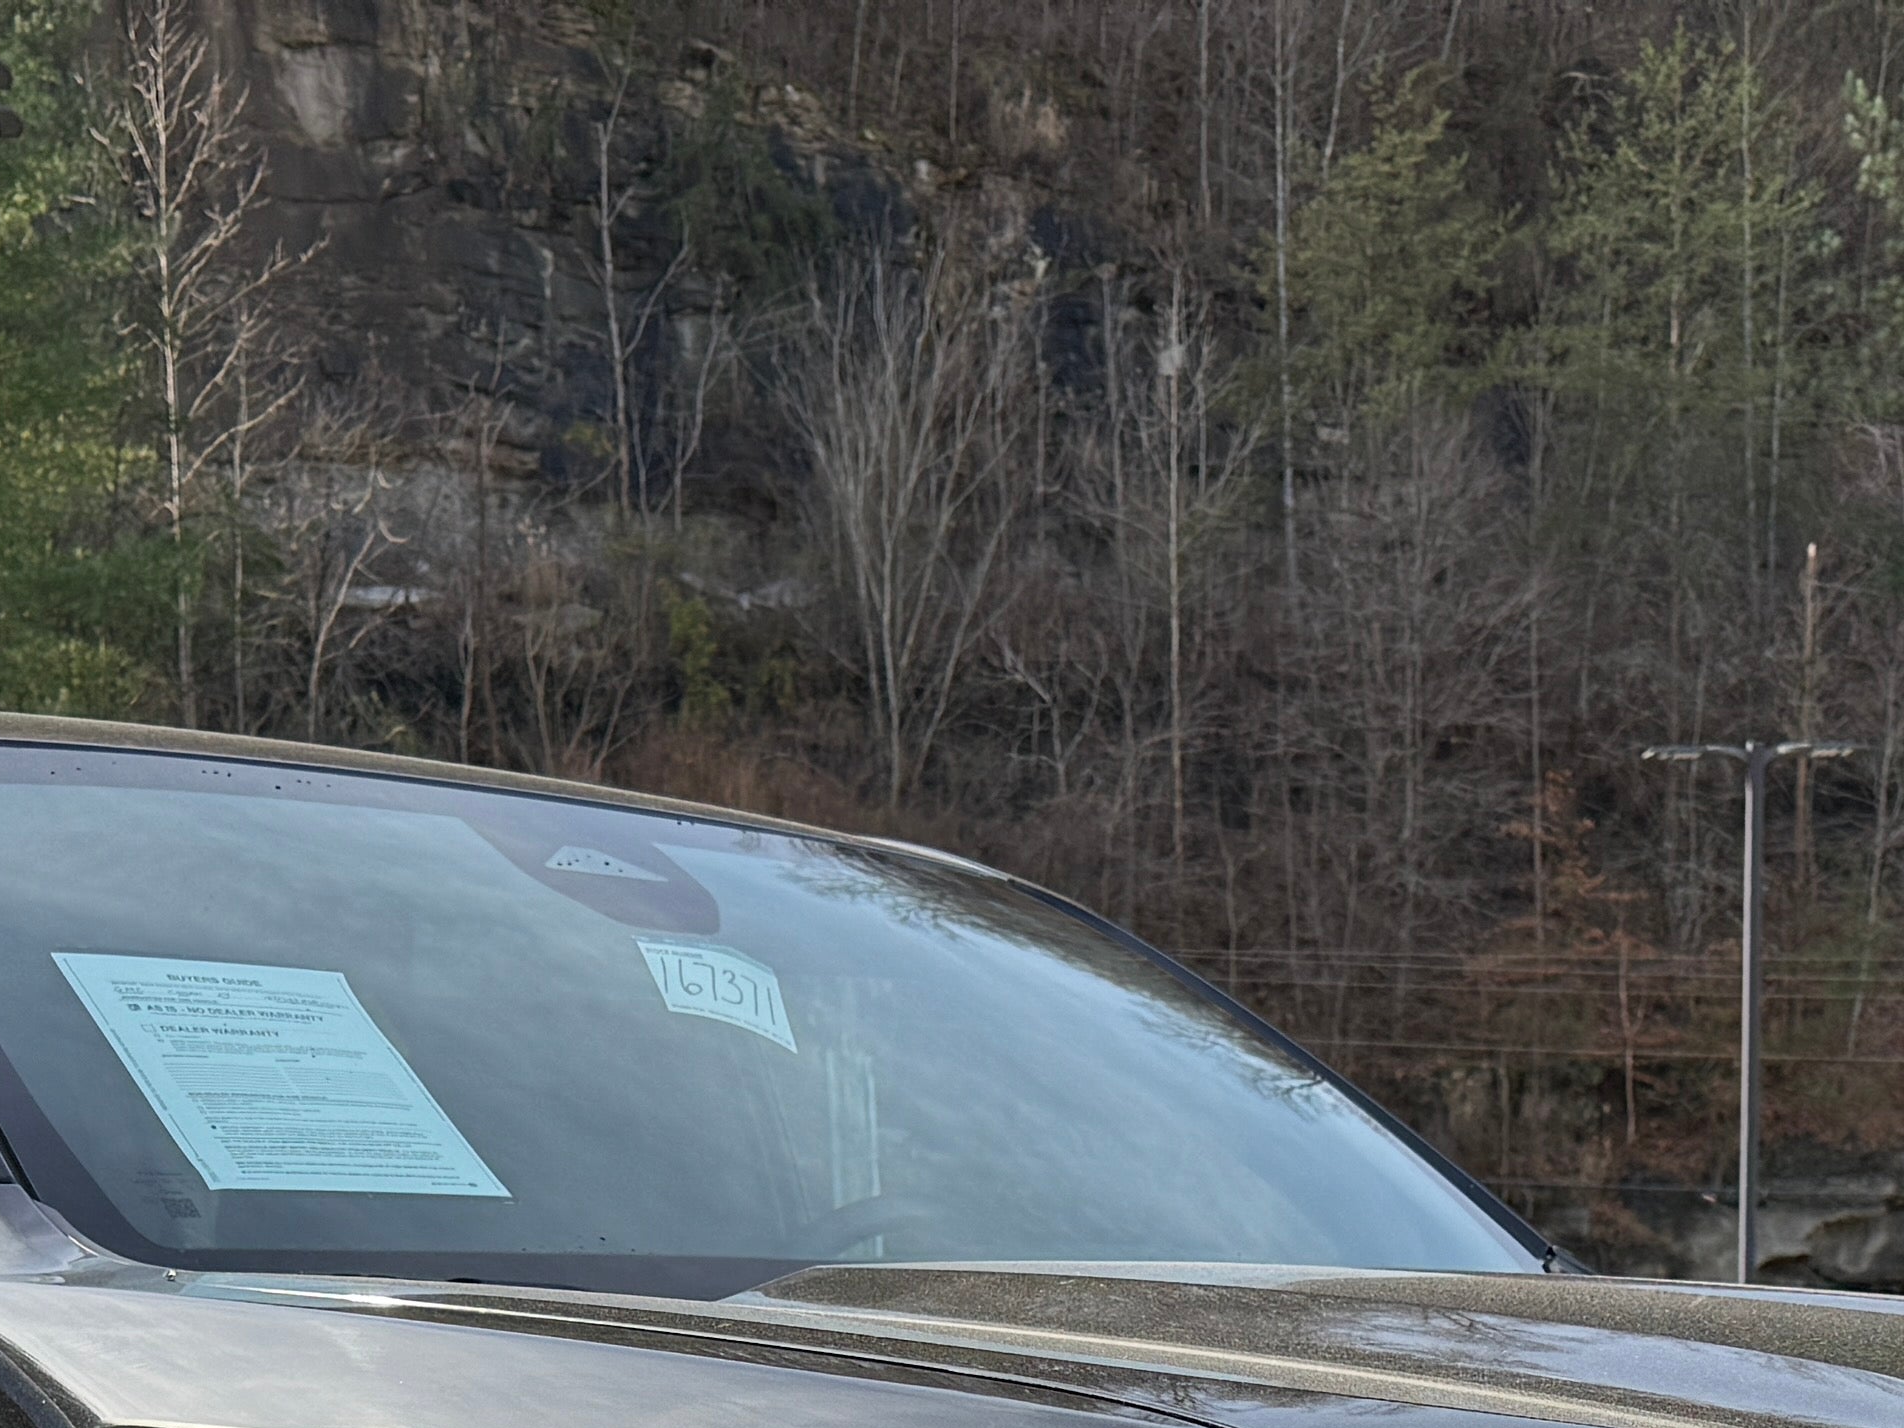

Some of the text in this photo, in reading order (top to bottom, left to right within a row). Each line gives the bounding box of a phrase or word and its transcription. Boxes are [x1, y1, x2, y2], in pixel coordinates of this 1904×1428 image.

[166, 973, 263, 988] BUYERS GUIDE
[660, 956, 777, 1026] 167371
[147, 1004, 164, 1012] AS
[187, 1006, 205, 1014] NO
[207, 1007, 256, 1017] DEALER
[258, 1011, 324, 1022] WARRANTY
[159, 1025, 279, 1038] DEALER WARRANTY
